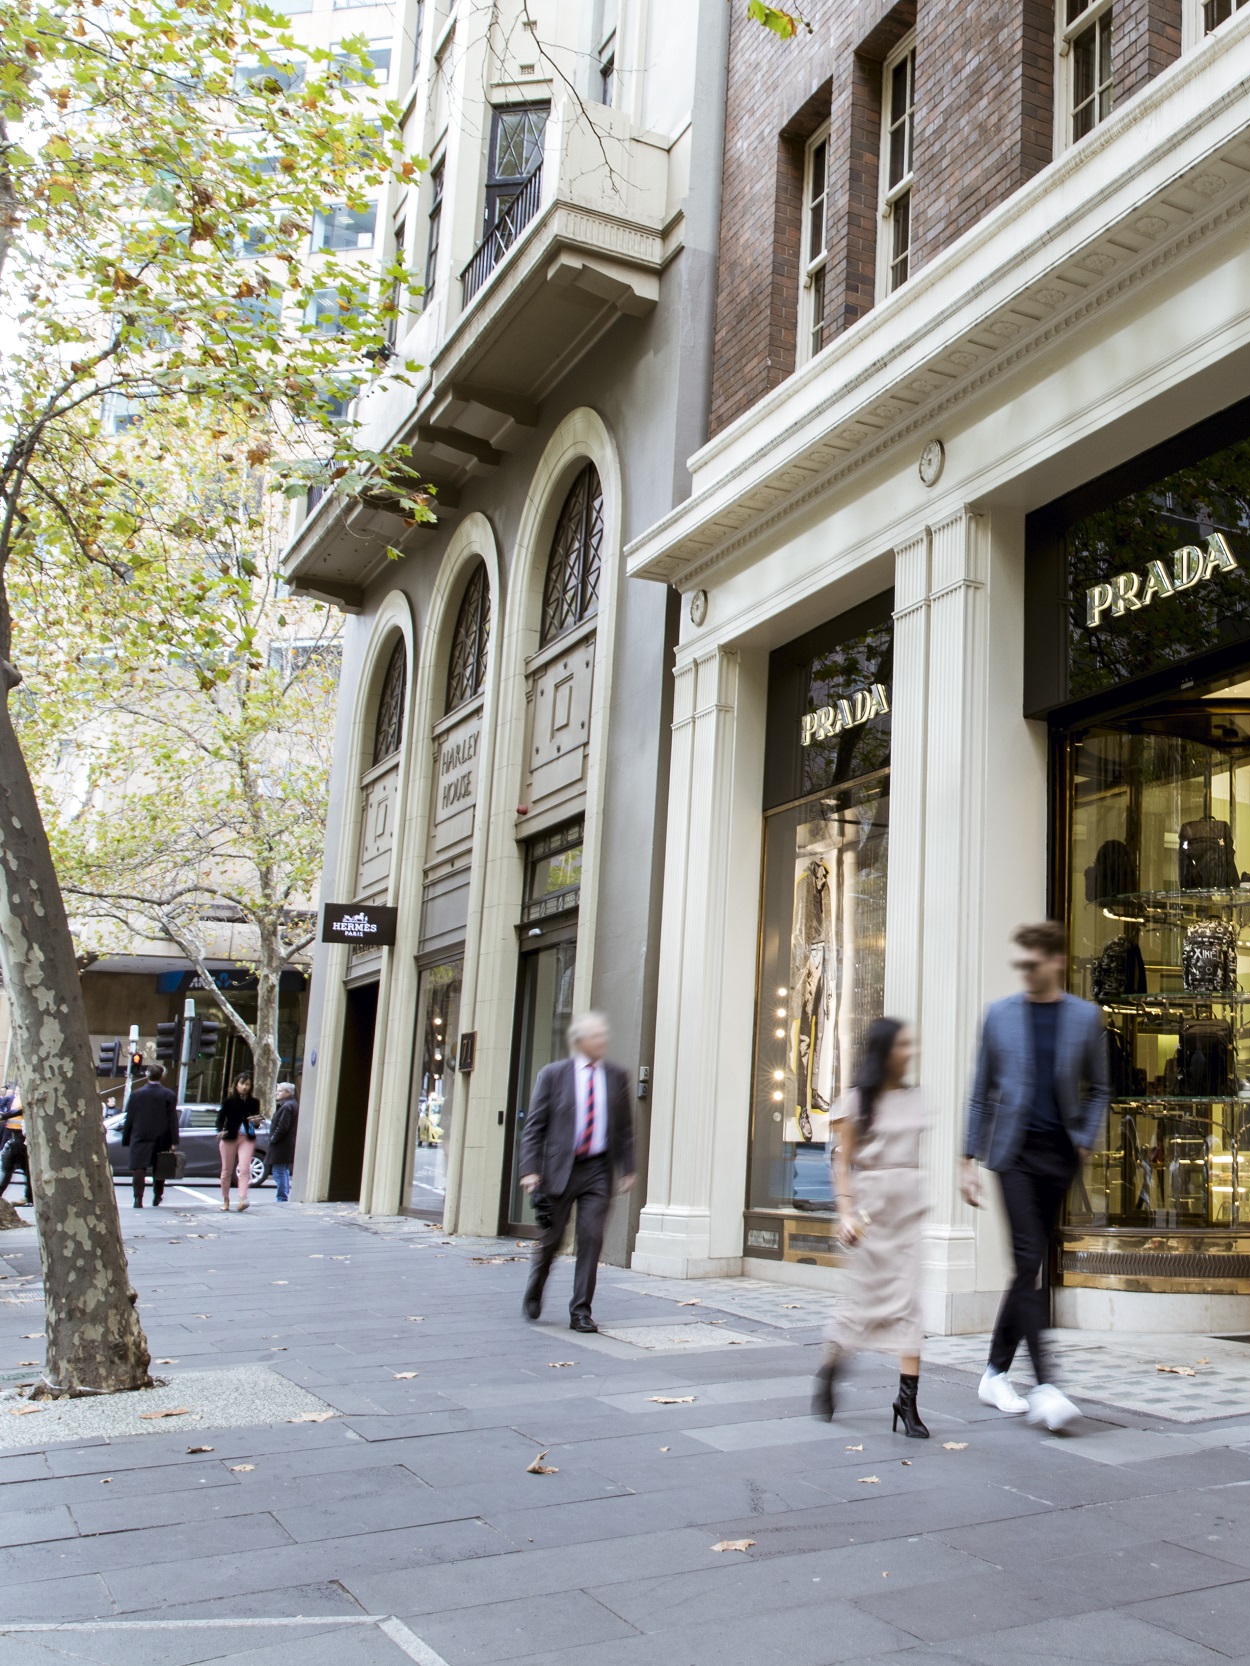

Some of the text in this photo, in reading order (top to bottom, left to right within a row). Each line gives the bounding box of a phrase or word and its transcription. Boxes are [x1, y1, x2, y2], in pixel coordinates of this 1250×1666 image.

[1086, 532, 1238, 627] PRADA
[801, 683, 890, 746] PRADA
[441, 730, 480, 776] HARLEY
[441, 770, 472, 809] HOUSE
